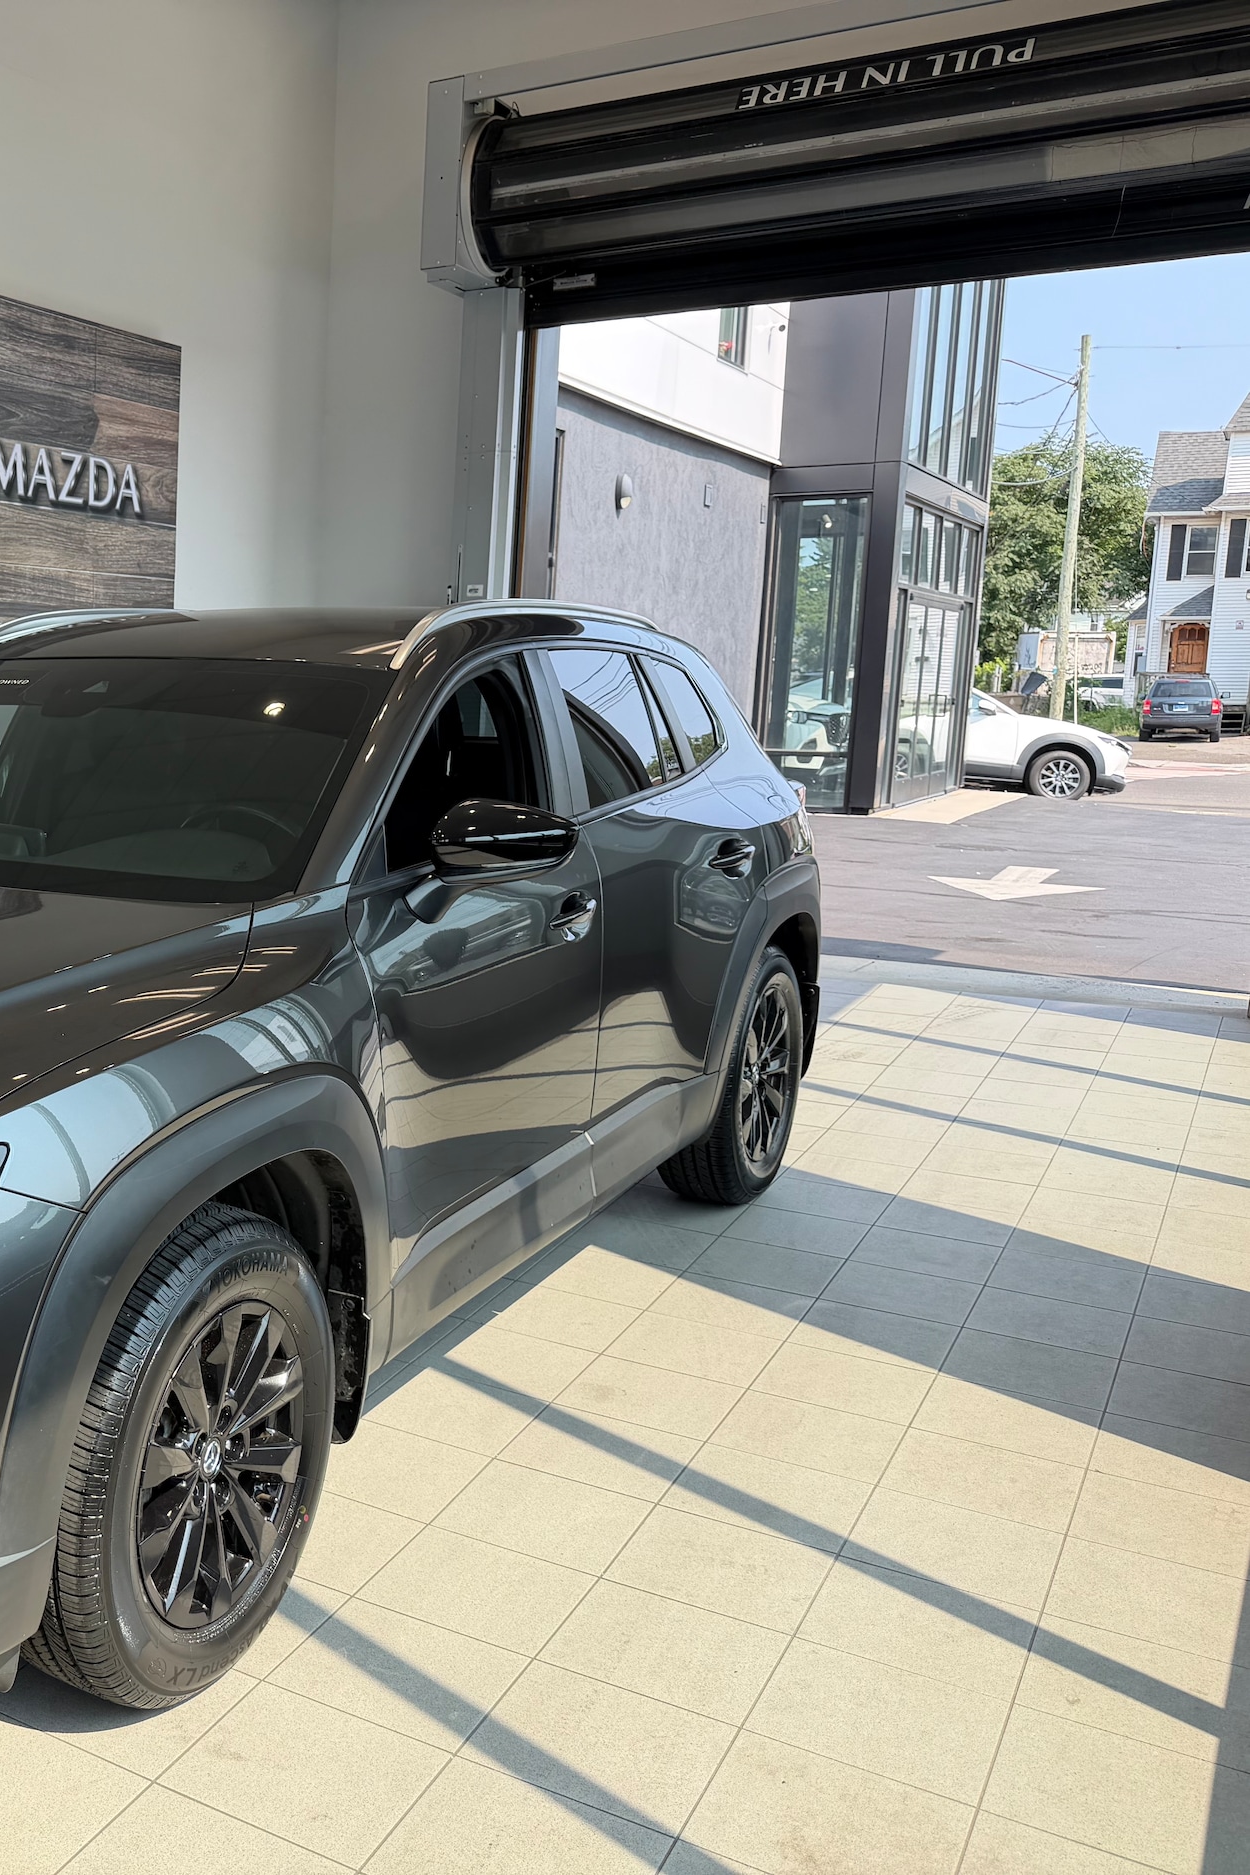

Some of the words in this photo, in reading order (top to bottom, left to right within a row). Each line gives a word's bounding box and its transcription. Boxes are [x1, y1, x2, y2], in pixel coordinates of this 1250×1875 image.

[860, 60, 910, 89] IN
[926, 38, 1036, 76] PULL
[738, 71, 848, 109] HERE
[214, 1251, 289, 1294] YOKOHAMA
